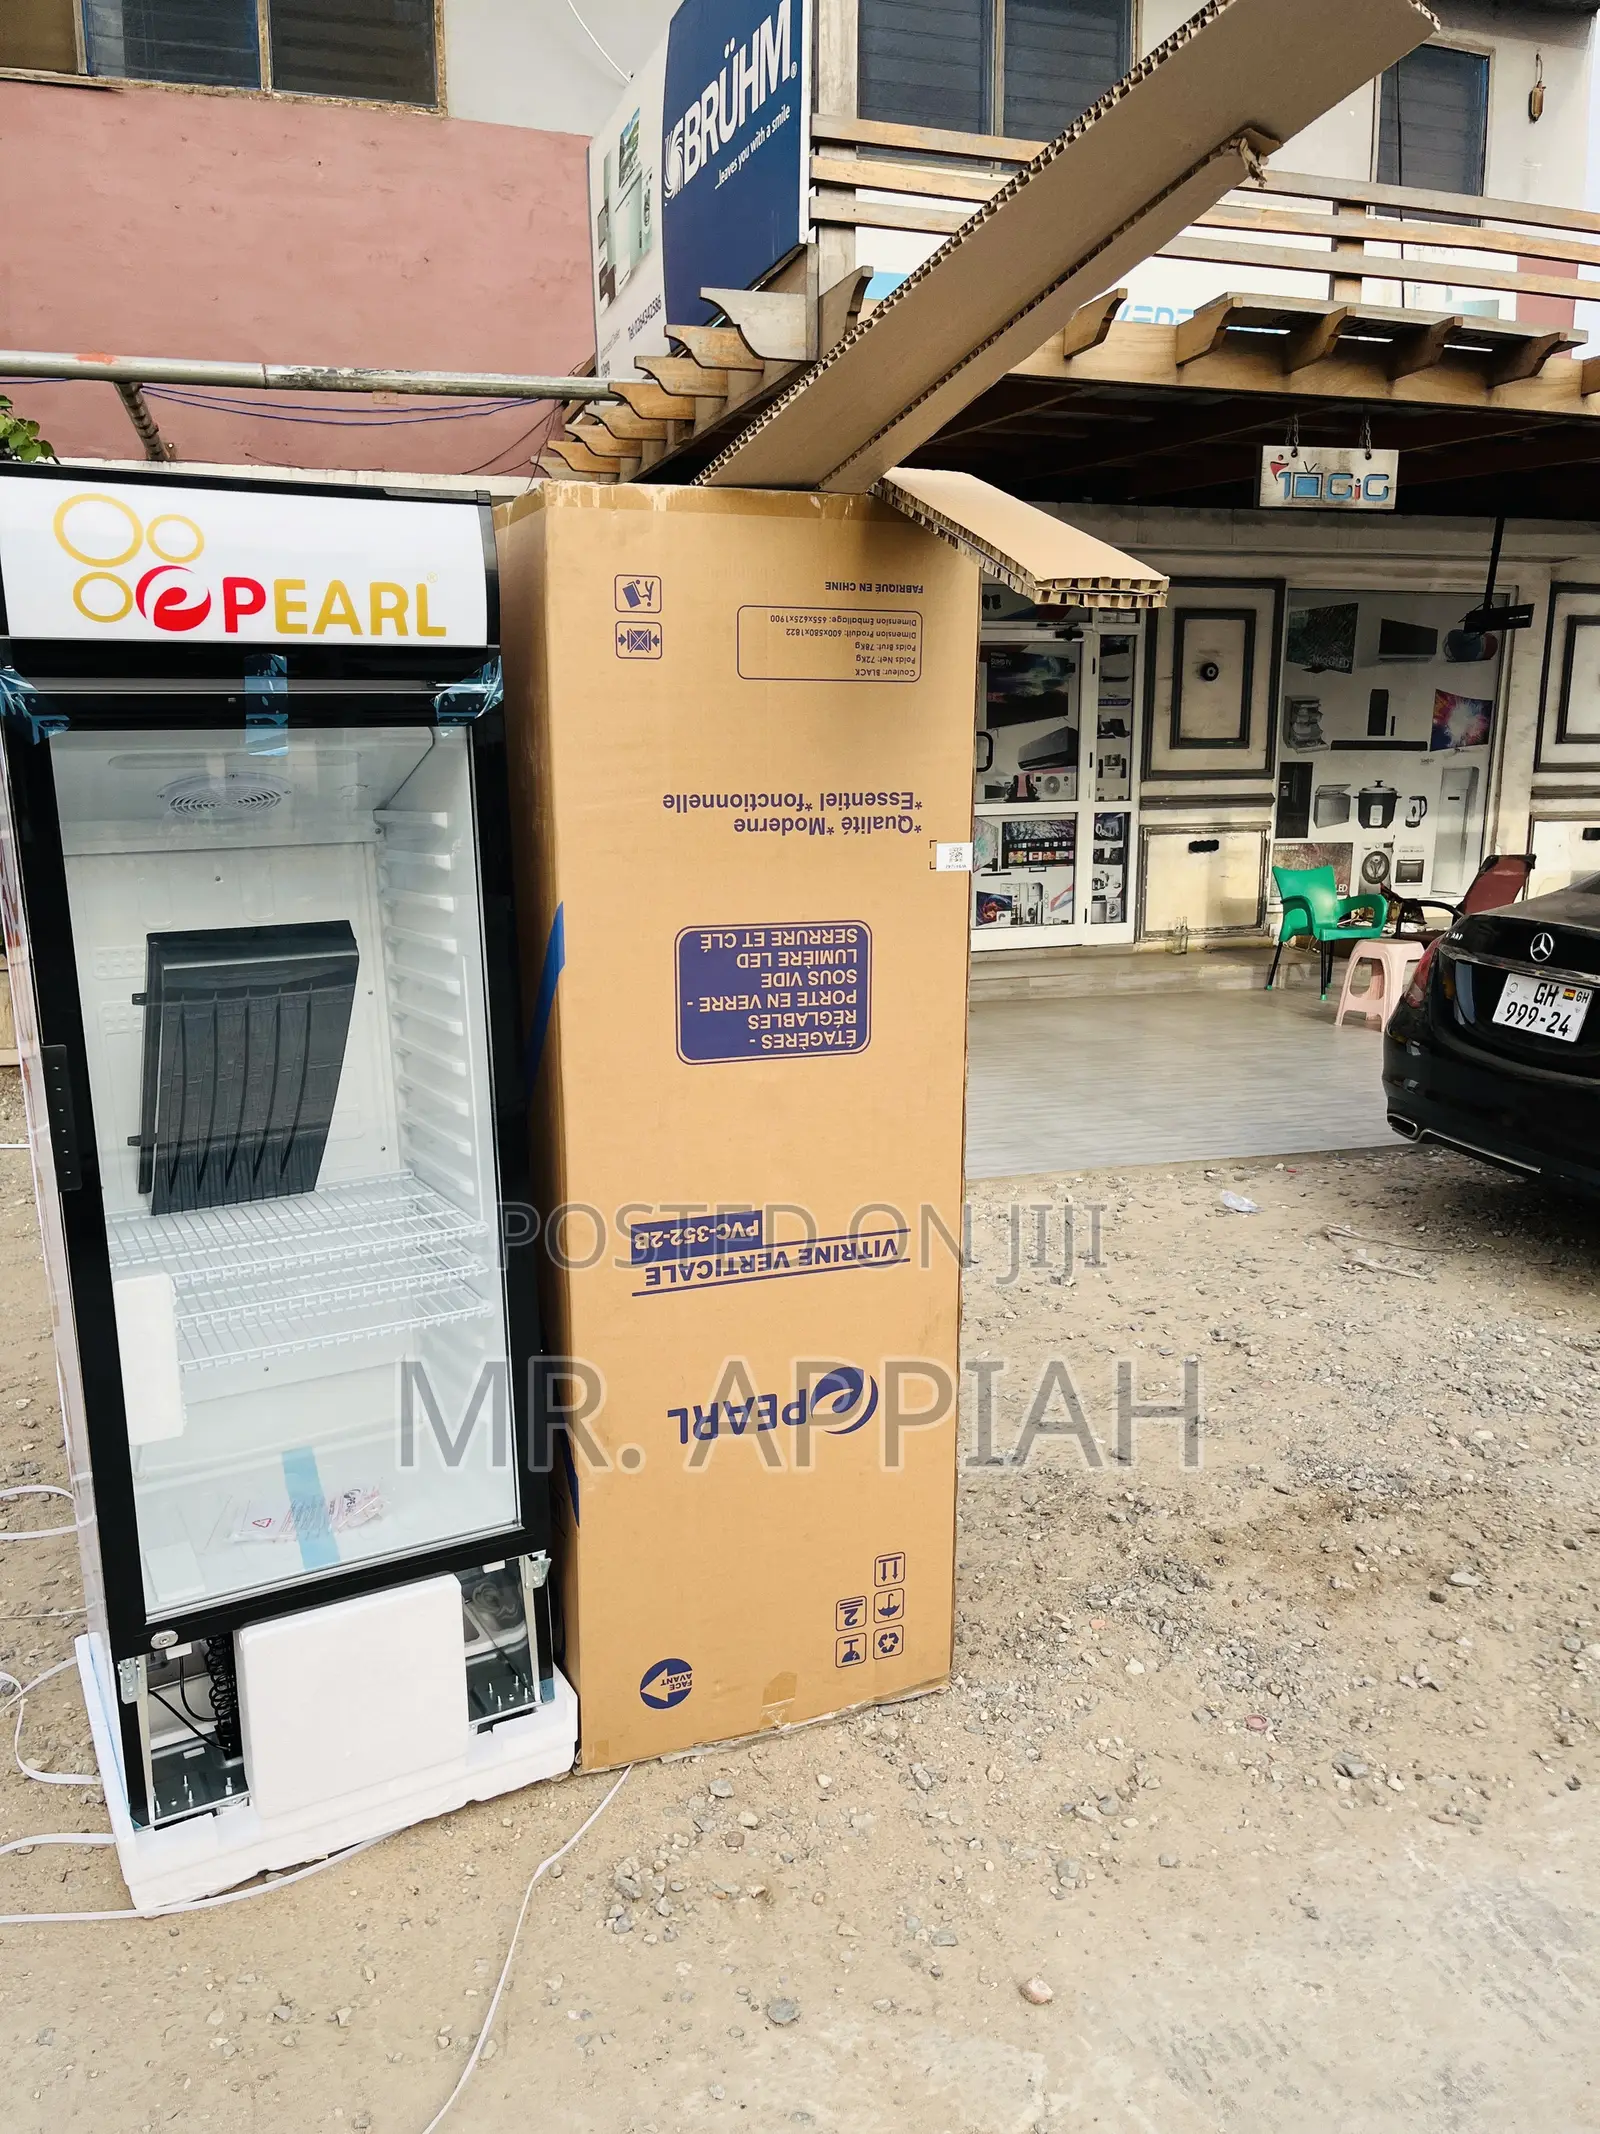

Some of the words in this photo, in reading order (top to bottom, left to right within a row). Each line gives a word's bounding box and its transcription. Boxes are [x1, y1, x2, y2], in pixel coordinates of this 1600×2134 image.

[684, 0, 792, 186] BRÜHM
[738, 145, 750, 171] you
[750, 127, 766, 153] with
[766, 124, 771, 138] a
[771, 104, 791, 133] smile
[825, 582, 856, 591] CHINE
[859, 583, 872, 592] EN
[876, 584, 923, 595] FABRIQUÉ
[222, 576, 447, 638] PEARL
[771, 615, 827, 624] 655x625x1900
[829, 616, 874, 626] Emballage:
[877, 618, 916, 626] Dimension
[786, 628, 842, 637] 600x580x1822
[844, 630, 874, 638] Produit:
[876, 631, 916, 639] Dimension
[855, 642, 874, 650] 78Kg
[877, 643, 893, 651] Brut:
[896, 644, 916, 652] Poids
[856, 654, 875, 663] 72Kg
[877, 656, 893, 664] Net:
[896, 656, 915, 664] Poids
[855, 668, 880, 676] BLACK
[883, 668, 915, 676] Couleur:
[700, 933, 737, 953] CLÉ
[743, 931, 765, 947] ET
[770, 928, 858, 945] SERRURE
[736, 952, 772, 968] LED
[778, 948, 857, 968] LUMIÈRE
[761, 972, 802, 988] VIDE
[808, 969, 857, 986] SOUS
[699, 994, 762, 1012] VERRE
[768, 992, 791, 1008] EN
[796, 989, 857, 1006] PORTE
[1533, 982, 1560, 1008] GH
[1576, 990, 1590, 1004] GH
[748, 1009, 856, 1030] RÉGLABLES
[1504, 1001, 1572, 1037] 999-24
[760, 1030, 856, 1050] ÉTAGÈRES
[634, 1218, 759, 1250] PVC-352-2B
[798, 1238, 898, 1268] VITRINE
[645, 1250, 790, 1286] VERTICALE
[667, 1388, 806, 1444] PEARL
[844, 1609, 858, 1625] 2
[660, 1672, 692, 1686] AVANT
[669, 1678, 692, 1691] FACE
